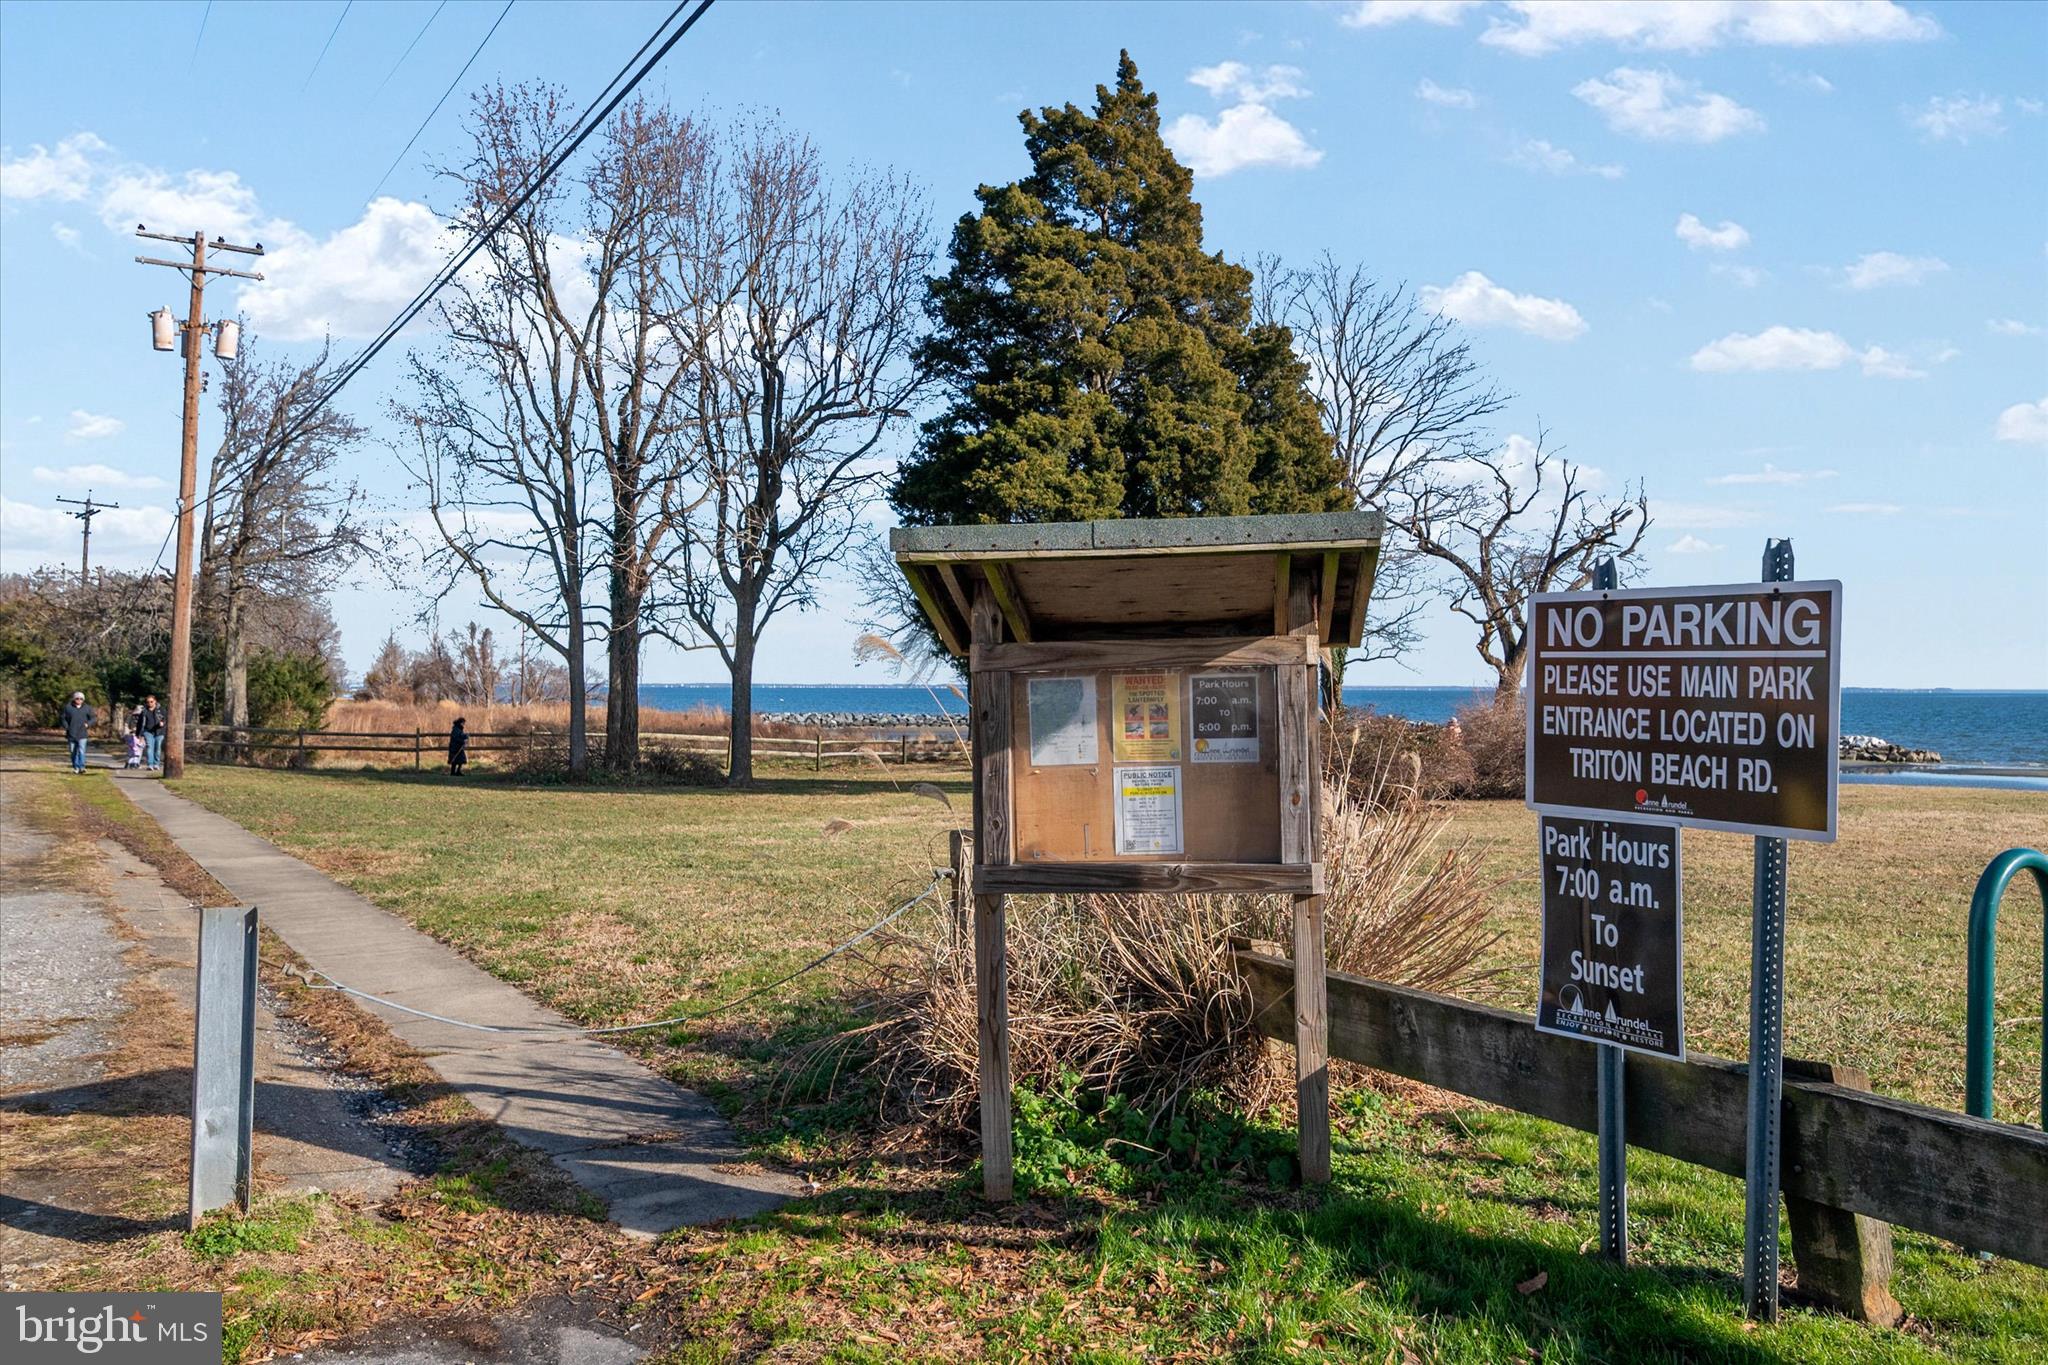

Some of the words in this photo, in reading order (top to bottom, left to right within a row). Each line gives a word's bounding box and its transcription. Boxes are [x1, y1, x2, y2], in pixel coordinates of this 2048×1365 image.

[1547, 607, 1603, 648] NO
[1622, 598, 1821, 647] PARKING
[1199, 680, 1220, 689] Park
[1222, 680, 1249, 688] Hours
[1543, 664, 1619, 697] PLEASE
[1627, 664, 1671, 697] USE
[1681, 665, 1737, 699] MAIN
[1748, 666, 1815, 700] PARK
[1196, 696, 1217, 705] 7:00
[1231, 697, 1252, 705] a.m.
[1198, 722, 1221, 732] 5:00
[1231, 723, 1252, 733] p.m.
[1543, 705, 1650, 741] ENTRANCE
[1660, 709, 1765, 746] LOCATED
[1777, 713, 1815, 749] ON
[1148, 771, 1172, 779] NOTICE
[1569, 747, 1642, 783] TRITON
[1651, 752, 1727, 790] BEACH
[1737, 758, 1778, 794] RD.
[1545, 825, 1591, 860] Park
[1601, 830, 1670, 870] Hours
[1555, 866, 1600, 901] 7:00
[1609, 879, 1660, 909] a.m.
[1591, 913, 1619, 948] To
[1570, 950, 1645, 995] Sunset
[1555, 1018, 1580, 1029] ENJOY
[1590, 1026, 1621, 1040] EXPLRE
[1630, 1035, 1664, 1048] RESTORE
[1556, 1011, 1612, 1029] RECREATION
[1615, 1023, 1631, 1033] AND
[1636, 1029, 1663, 1040] PARKS
